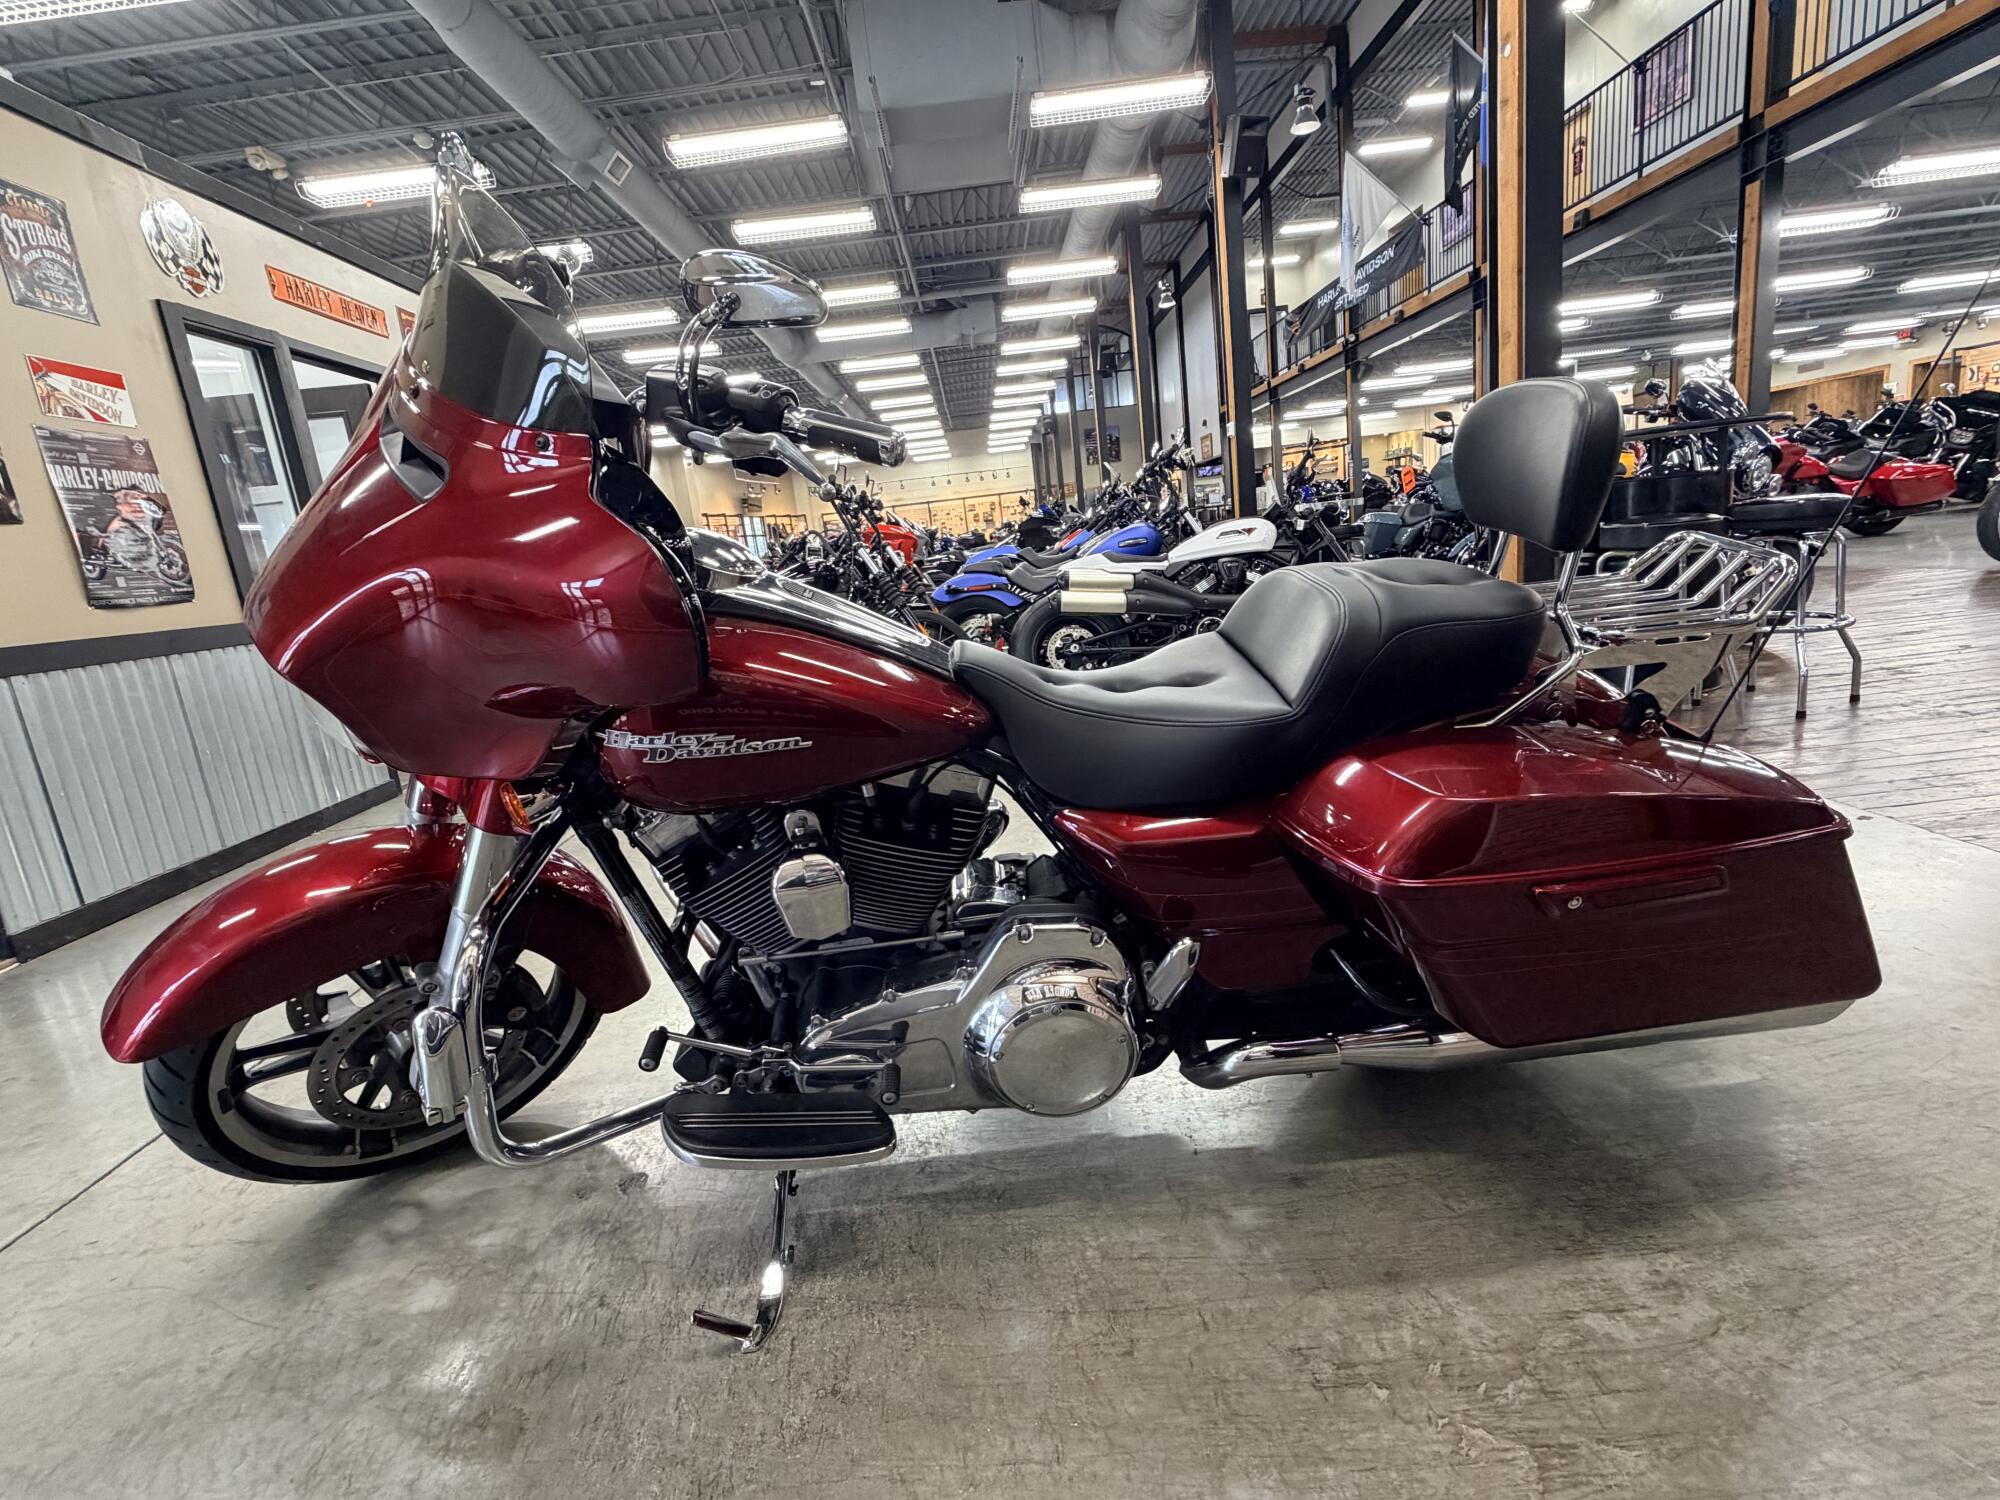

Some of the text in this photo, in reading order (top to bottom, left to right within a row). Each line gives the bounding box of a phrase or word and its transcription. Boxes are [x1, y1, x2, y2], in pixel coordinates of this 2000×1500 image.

[1, 212, 72, 260] STURGIS
[283, 275, 379, 331] HARLEY HEAVEN
[69, 387, 123, 424] DAVIDSON
[71, 379, 124, 404] HARLEY-
[47, 463, 165, 494] HARLEY-DAVIDSON
[643, 736, 813, 763] Davidson
